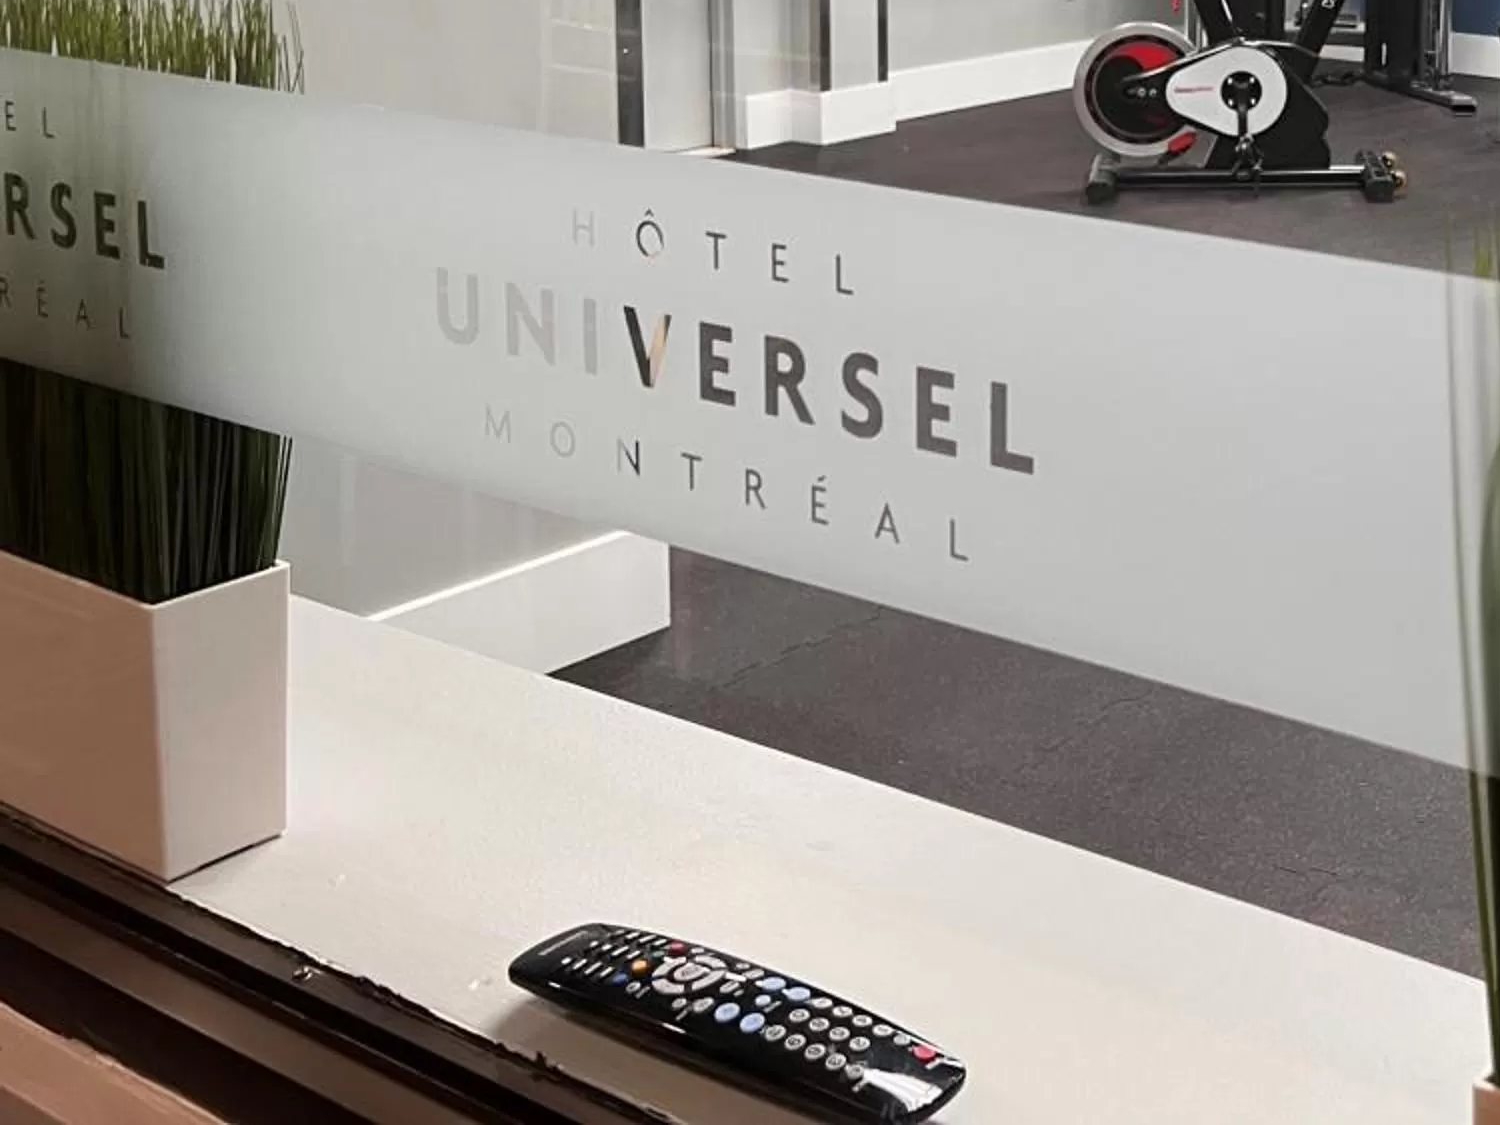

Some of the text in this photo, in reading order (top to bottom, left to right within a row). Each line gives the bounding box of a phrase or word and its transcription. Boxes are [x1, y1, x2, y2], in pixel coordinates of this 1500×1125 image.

[3, 171, 166, 270] RSEL
[571, 208, 855, 296] HÔTEL
[435, 267, 1035, 476] UNIVERSEL
[484, 405, 970, 562] MONTRÉAL
